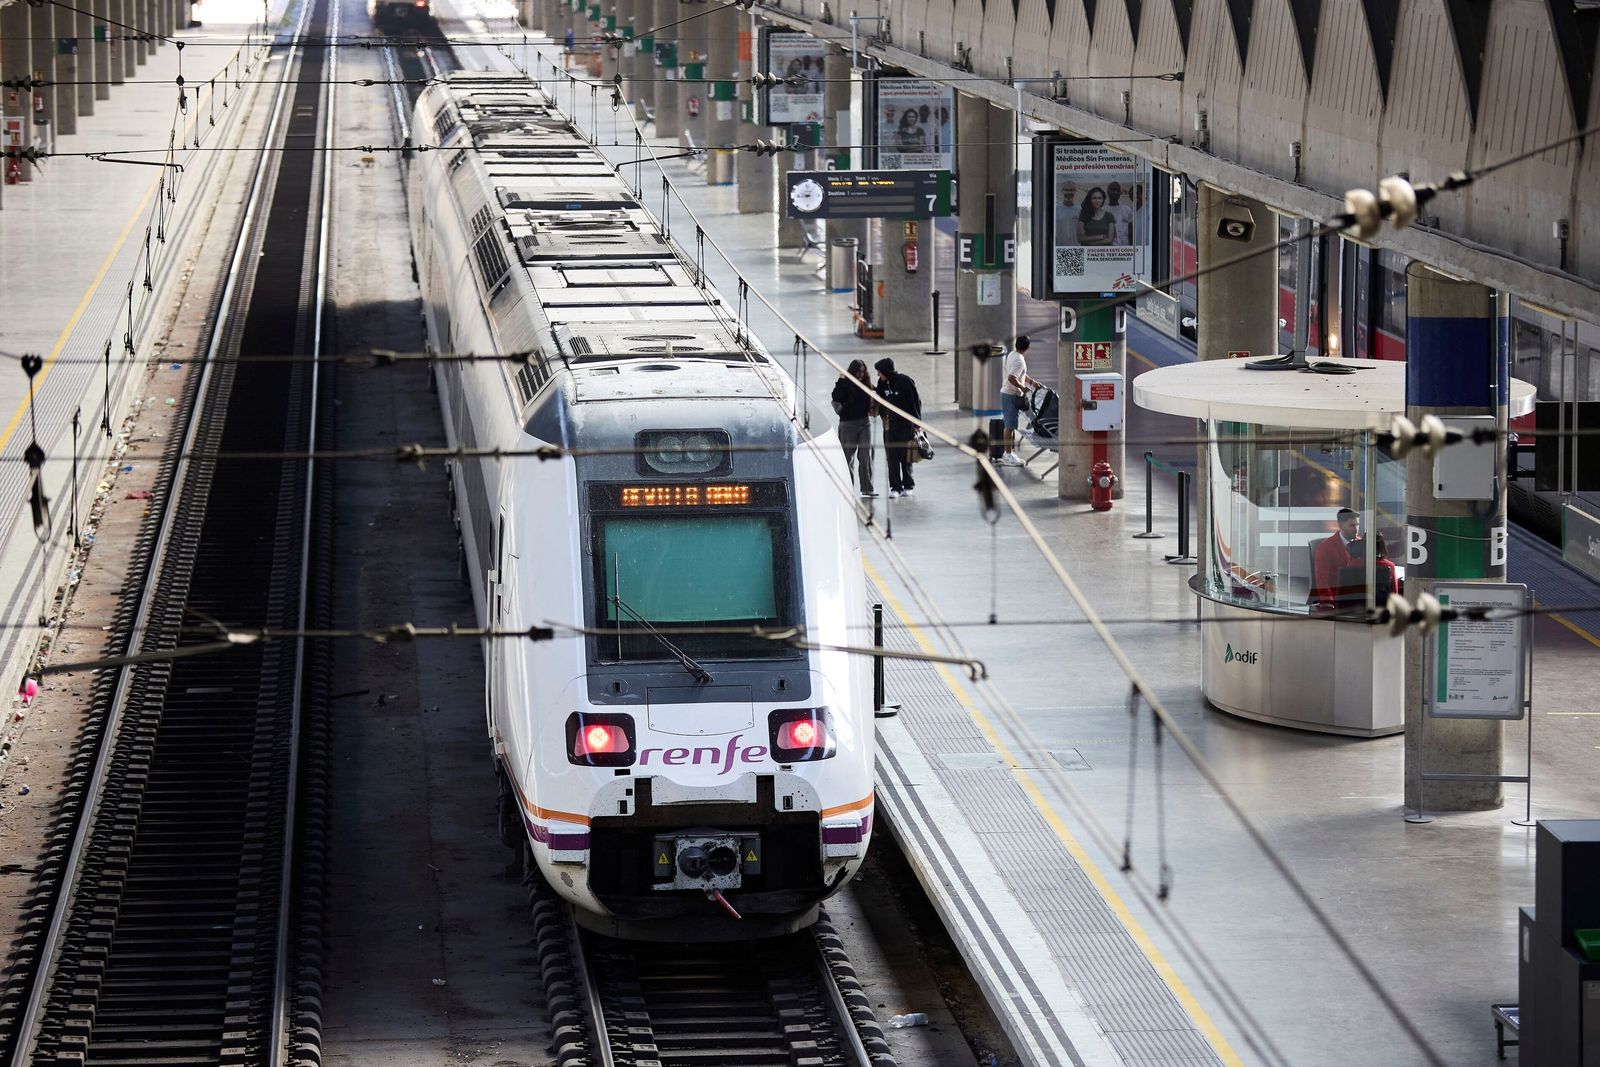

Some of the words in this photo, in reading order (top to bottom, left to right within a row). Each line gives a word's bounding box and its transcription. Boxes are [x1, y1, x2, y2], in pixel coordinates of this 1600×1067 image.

[678, 66, 687, 79] K
[1064, 147, 1098, 155] trabajaras
[1056, 163, 1073, 171] ¿qué
[1074, 163, 1106, 171] profesión
[925, 194, 937, 212] 7
[960, 239, 972, 263] E
[1004, 239, 1015, 263] E
[1061, 306, 1077, 333] D
[1406, 526, 1428, 565] B
[1490, 526, 1506, 566] B
[1235, 650, 1258, 664] adif
[639, 734, 768, 776] renfe
